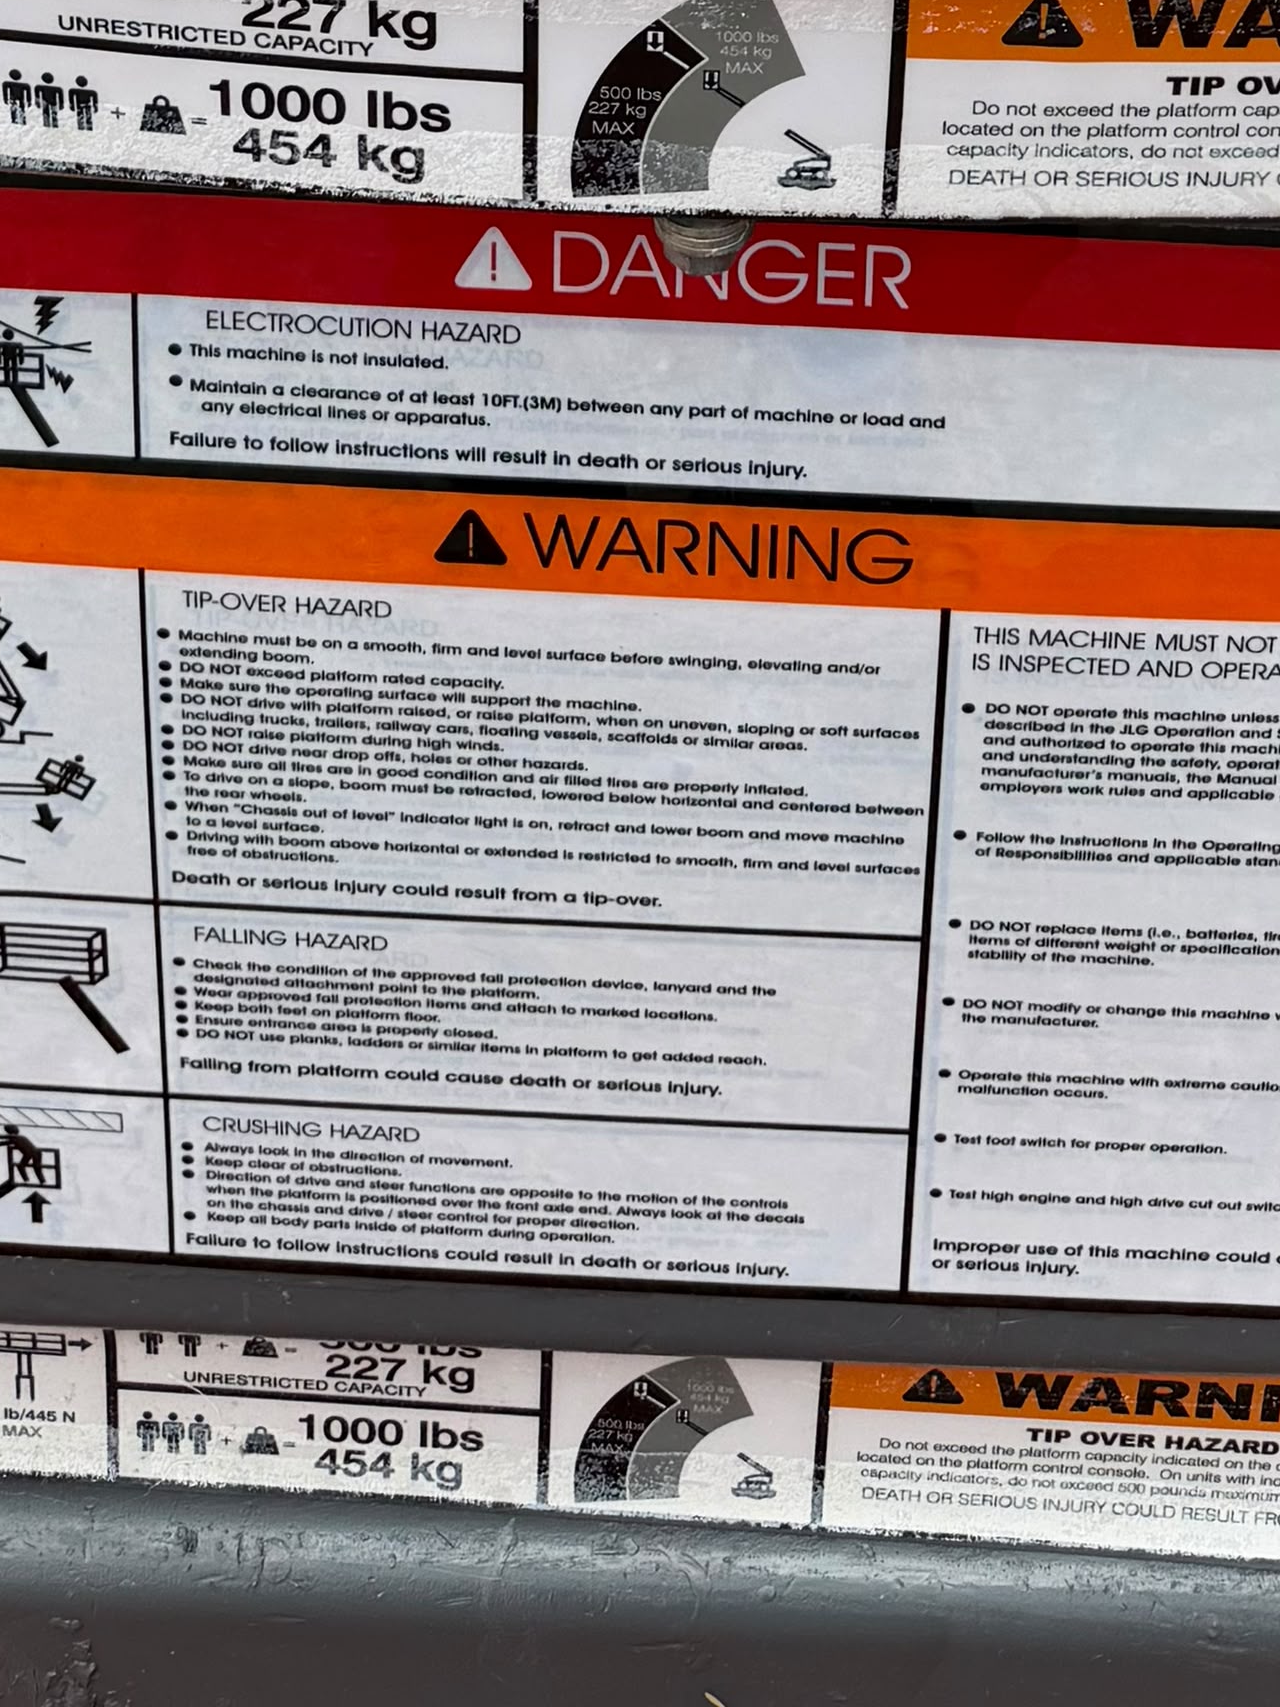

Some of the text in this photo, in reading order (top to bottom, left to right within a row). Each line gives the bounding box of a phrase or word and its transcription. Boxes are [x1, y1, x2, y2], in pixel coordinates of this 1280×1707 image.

[57, 14, 375, 57] UNRESTRICTED CAPACITY
[368, 0, 437, 51] kg
[600, 86, 662, 101] 500 lbs
[1166, 77, 1225, 95] TIP
[210, 80, 451, 132] 1000 lbs
[589, 101, 646, 119] 227 kg
[973, 101, 1000, 116] Do
[1007, 103, 1036, 116] not
[1044, 102, 1113, 117] exceed
[1121, 104, 1150, 117] the
[1156, 103, 1236, 120] platform
[593, 121, 634, 134] MAX
[233, 128, 424, 184] 454 kg
[207, 310, 521, 344] ELECTROCUTION HAZARD
[190, 343, 448, 369] This machine is not insulated.
[190, 379, 266, 396] Maintain
[273, 385, 284, 397] a
[291, 384, 381, 402] clearance
[387, 390, 404, 403] of
[410, 390, 427, 404] at
[434, 391, 474, 407] least
[568, 398, 644, 415] between
[650, 404, 683, 418] any
[689, 405, 725, 419] part
[731, 406, 748, 419] of
[755, 409, 834, 424] machine
[840, 414, 857, 425] or
[863, 411, 903, 427] load
[909, 416, 945, 429] and
[201, 401, 490, 427] any electrical lines or apparatus.
[170, 431, 806, 481] Failure to follow instructions will result in death or serious injury.
[524, 512, 914, 585] WARNING
[183, 590, 391, 618] TIP-OVER HAZARD
[974, 627, 1019, 646] THIS
[1029, 628, 1145, 650] MACHINE
[1156, 633, 1218, 652] MUST
[1227, 635, 1277, 654] NOT
[973, 653, 989, 671] IS
[1000, 654, 1130, 676] INSPECTED
[1137, 660, 1192, 678] AND
[194, 926, 388, 951] FALLING HAZARD
[203, 1117, 420, 1142] CRUSHING HAZARD
[183, 1371, 428, 1398] UNRESTRICTED CAPACITY
[325, 1354, 476, 1393] 227 kg
[299, 1414, 483, 1451] 1000 lbs
[1027, 1428, 1279, 1457] TIP OVER HAZARD
[315, 1449, 462, 1491] 454 kg
